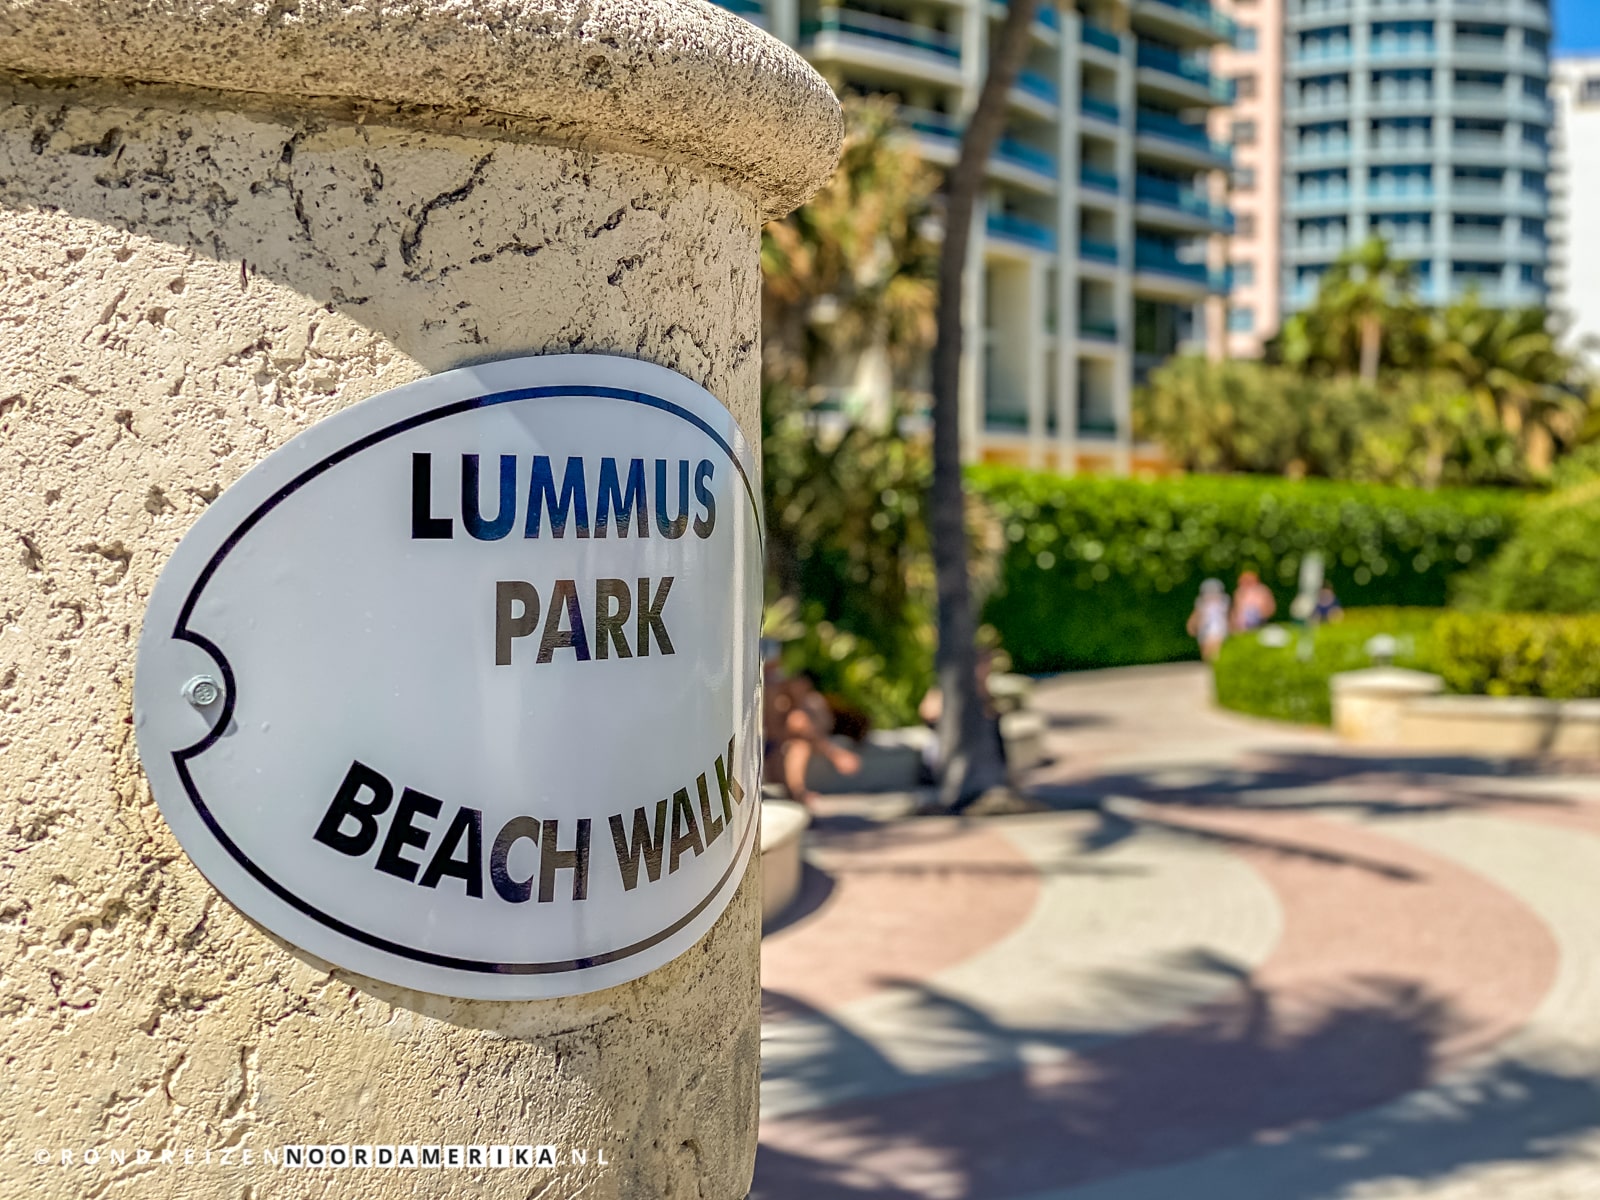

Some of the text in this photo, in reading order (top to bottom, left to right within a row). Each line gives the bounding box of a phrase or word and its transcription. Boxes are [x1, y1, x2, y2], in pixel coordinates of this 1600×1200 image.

[411, 452, 717, 541] LUMMUS
[495, 576, 676, 666] PARK
[312, 733, 745, 904] BEACH WALK
